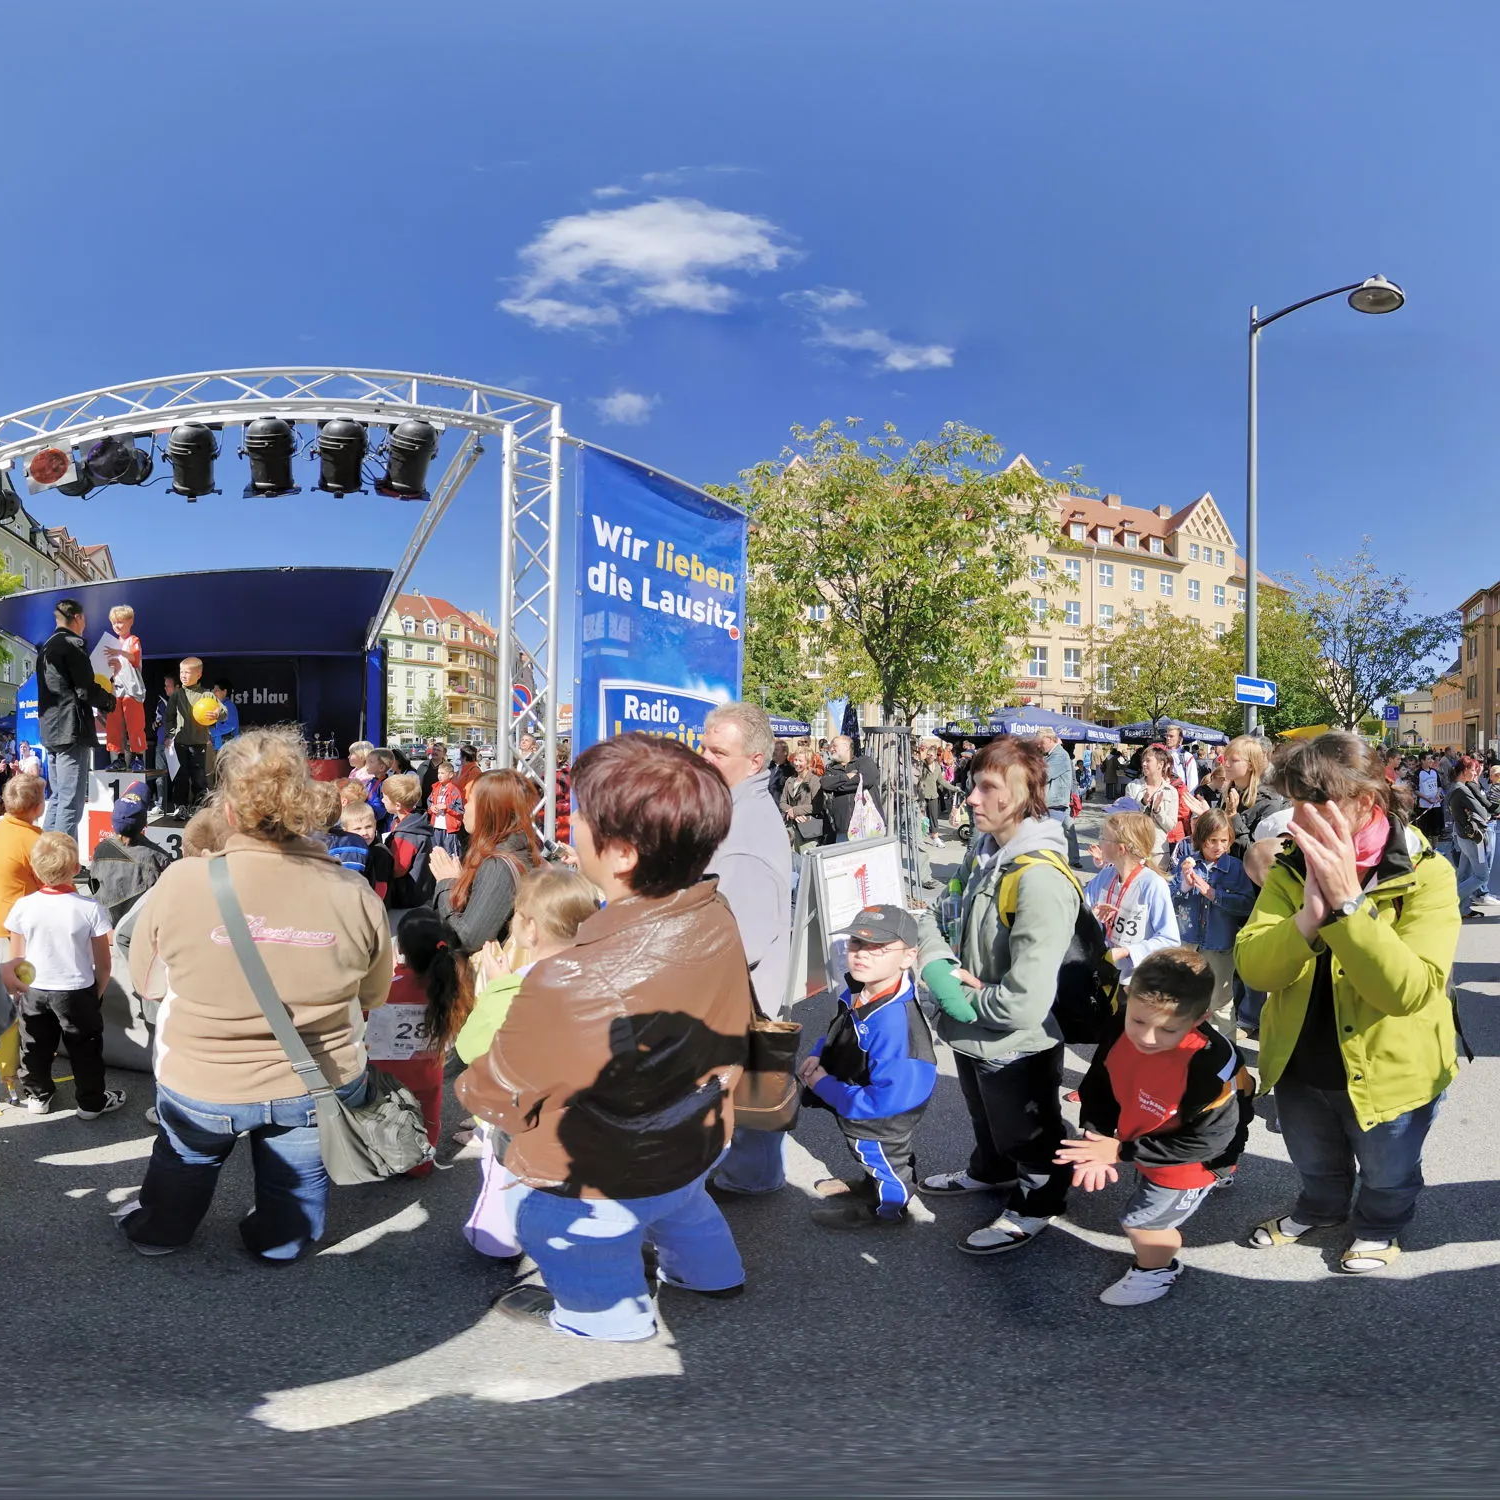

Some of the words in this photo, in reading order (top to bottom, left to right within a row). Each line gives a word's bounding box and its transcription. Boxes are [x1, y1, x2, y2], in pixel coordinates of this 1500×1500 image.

[591, 514, 650, 562] Wir
[655, 540, 735, 594] lieben
[587, 561, 633, 602] die
[641, 577, 737, 631] Lausitz
[230, 688, 249, 704] ist
[252, 687, 289, 704] blau
[624, 694, 680, 724] Radio
[1387, 707, 1395, 719] P
[166, 834, 184, 860] 3
